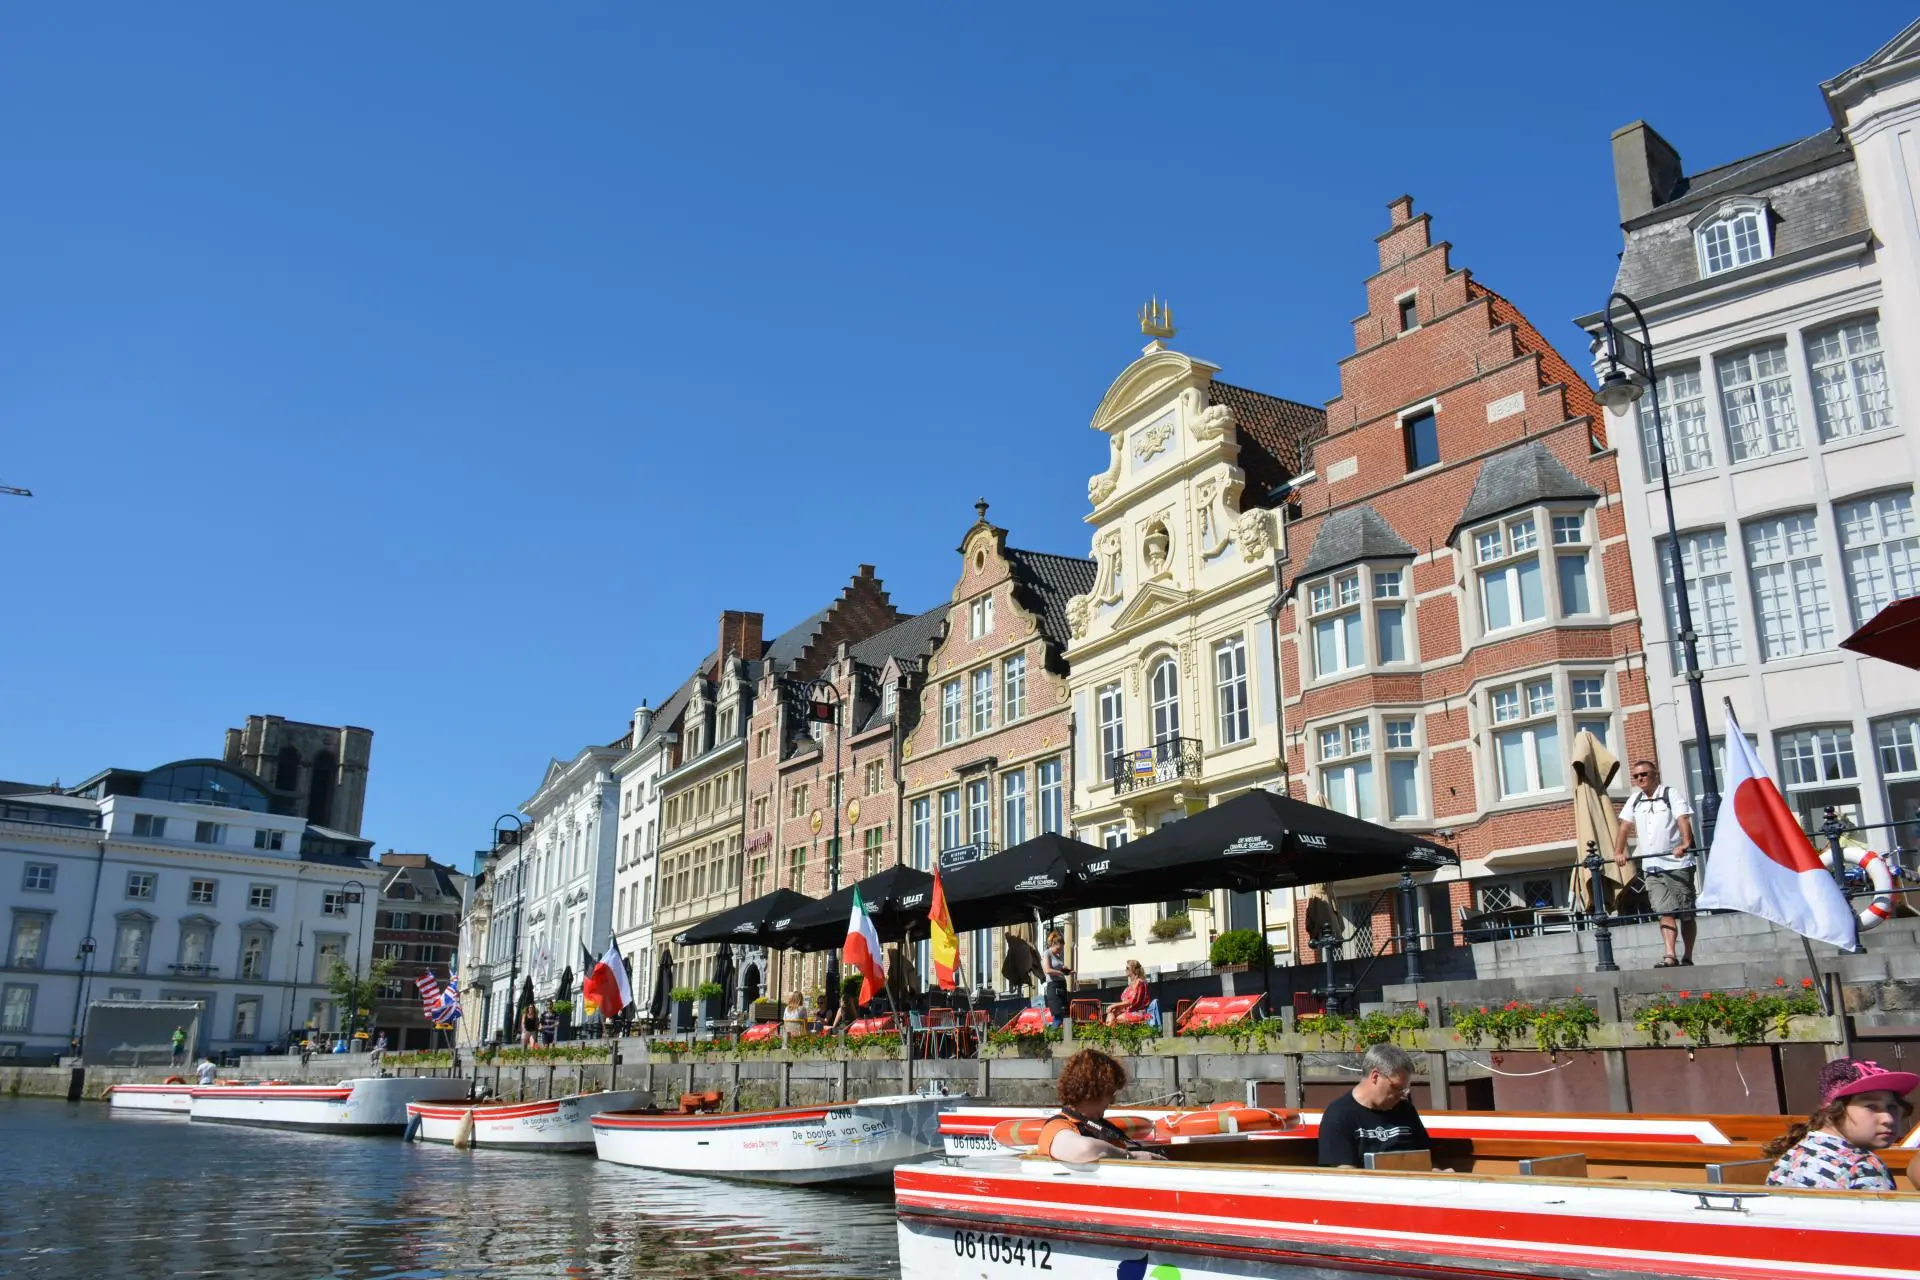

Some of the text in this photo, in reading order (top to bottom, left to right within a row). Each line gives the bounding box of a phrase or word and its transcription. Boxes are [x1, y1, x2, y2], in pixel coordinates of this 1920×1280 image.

[1298, 834, 1326, 846] LILLET
[792, 1120, 888, 1141] De bootjes van Gent
[954, 1230, 1052, 1270] 06105412
